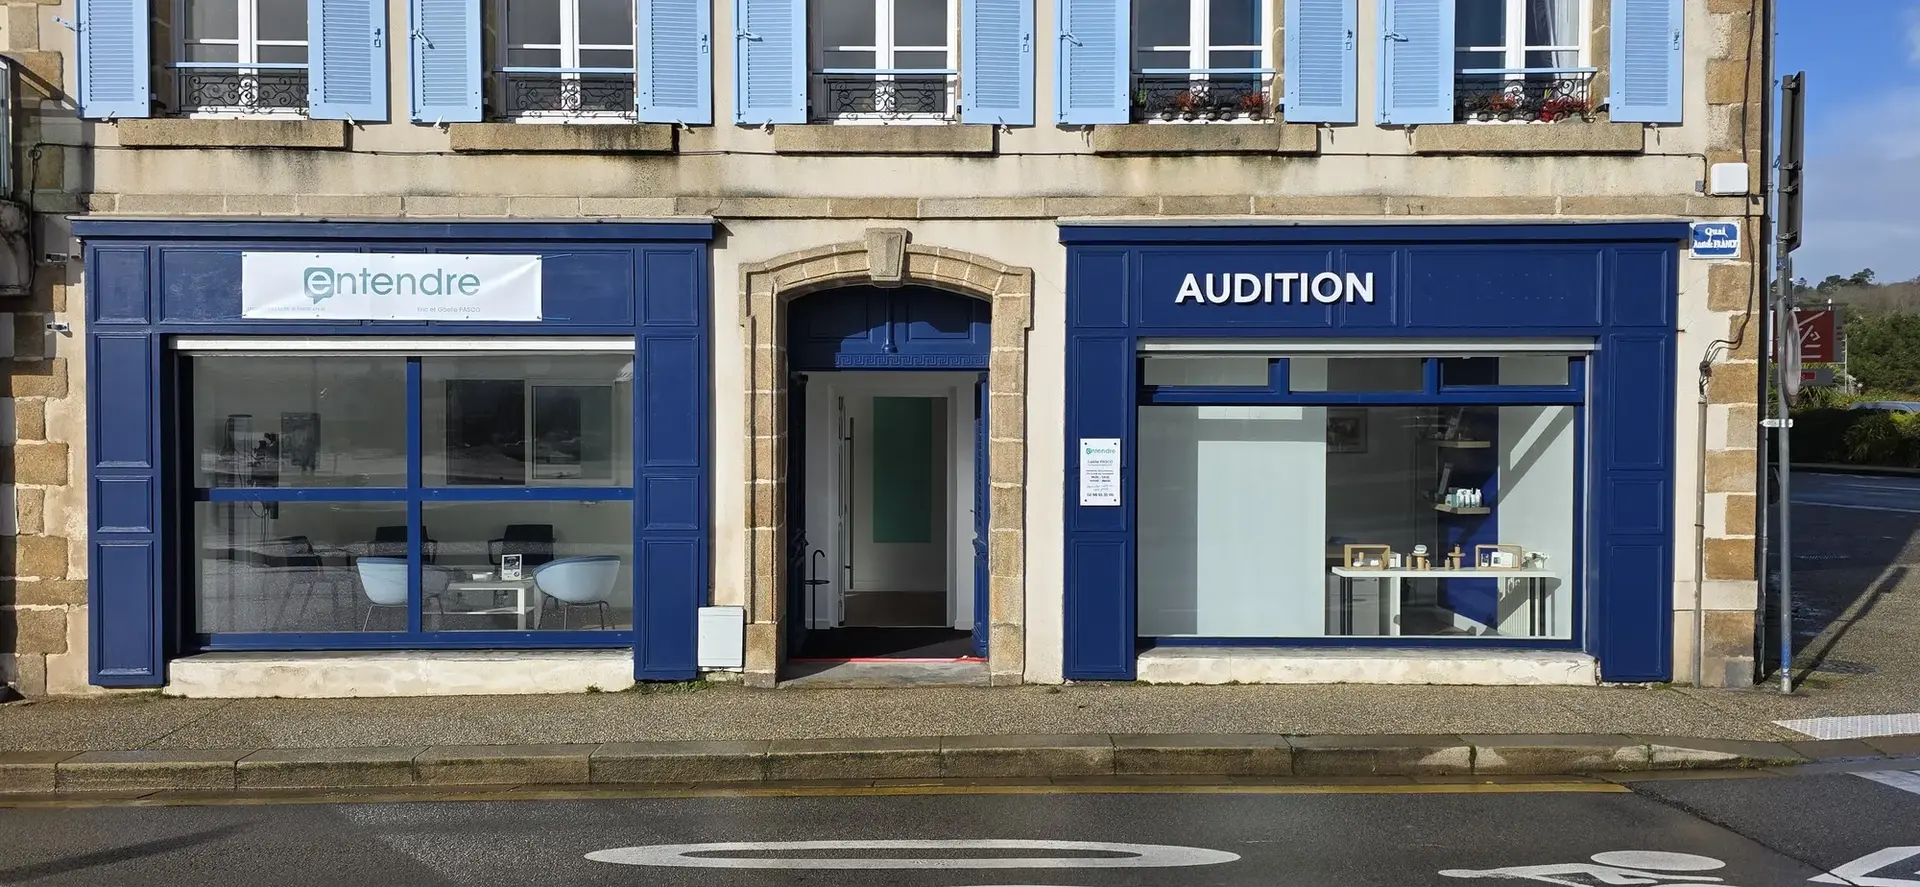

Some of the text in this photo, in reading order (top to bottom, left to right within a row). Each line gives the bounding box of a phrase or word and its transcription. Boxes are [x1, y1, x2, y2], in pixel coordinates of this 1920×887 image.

[1704, 226, 1728, 239] Quai
[304, 267, 481, 304] entendre
[1174, 271, 1374, 303] AUDITION
